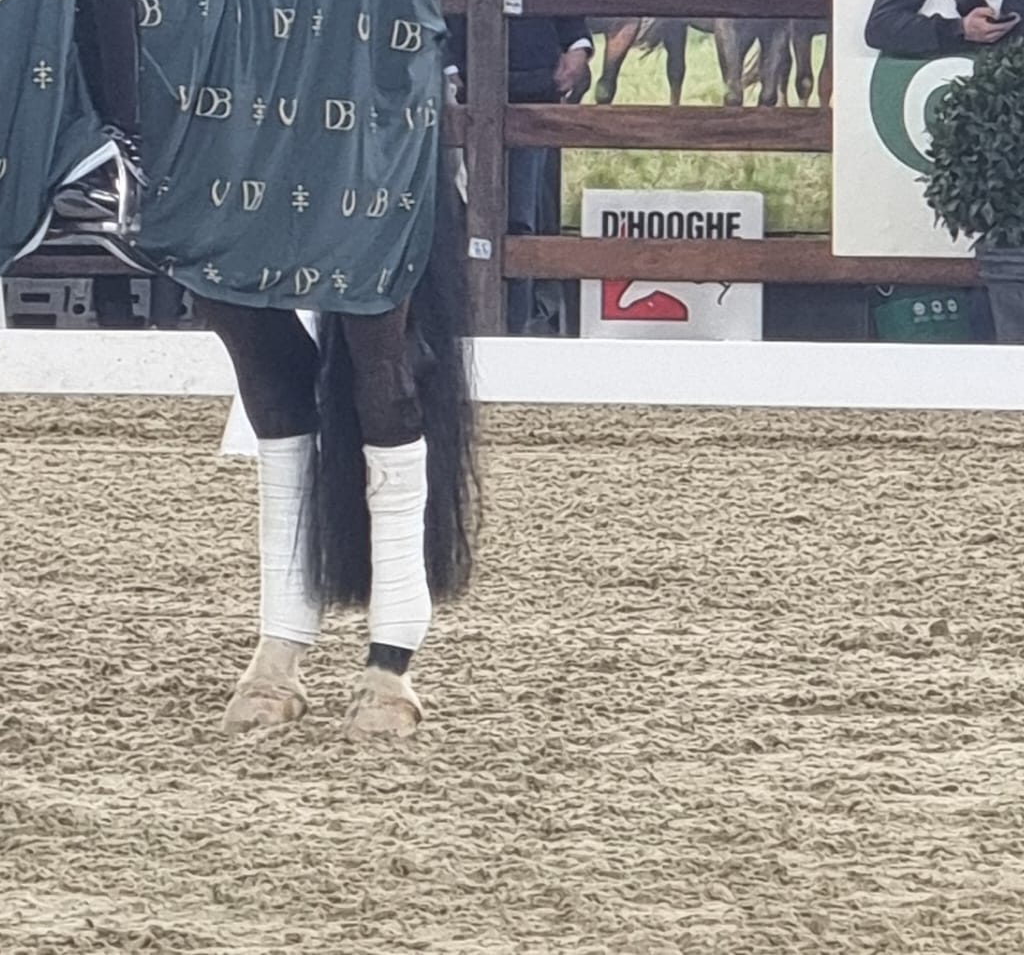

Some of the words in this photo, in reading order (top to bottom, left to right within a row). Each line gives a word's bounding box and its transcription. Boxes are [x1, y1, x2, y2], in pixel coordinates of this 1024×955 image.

[390, 19, 421, 52] DB
[195, 86, 232, 119] DB
[326, 99, 355, 131] DB
